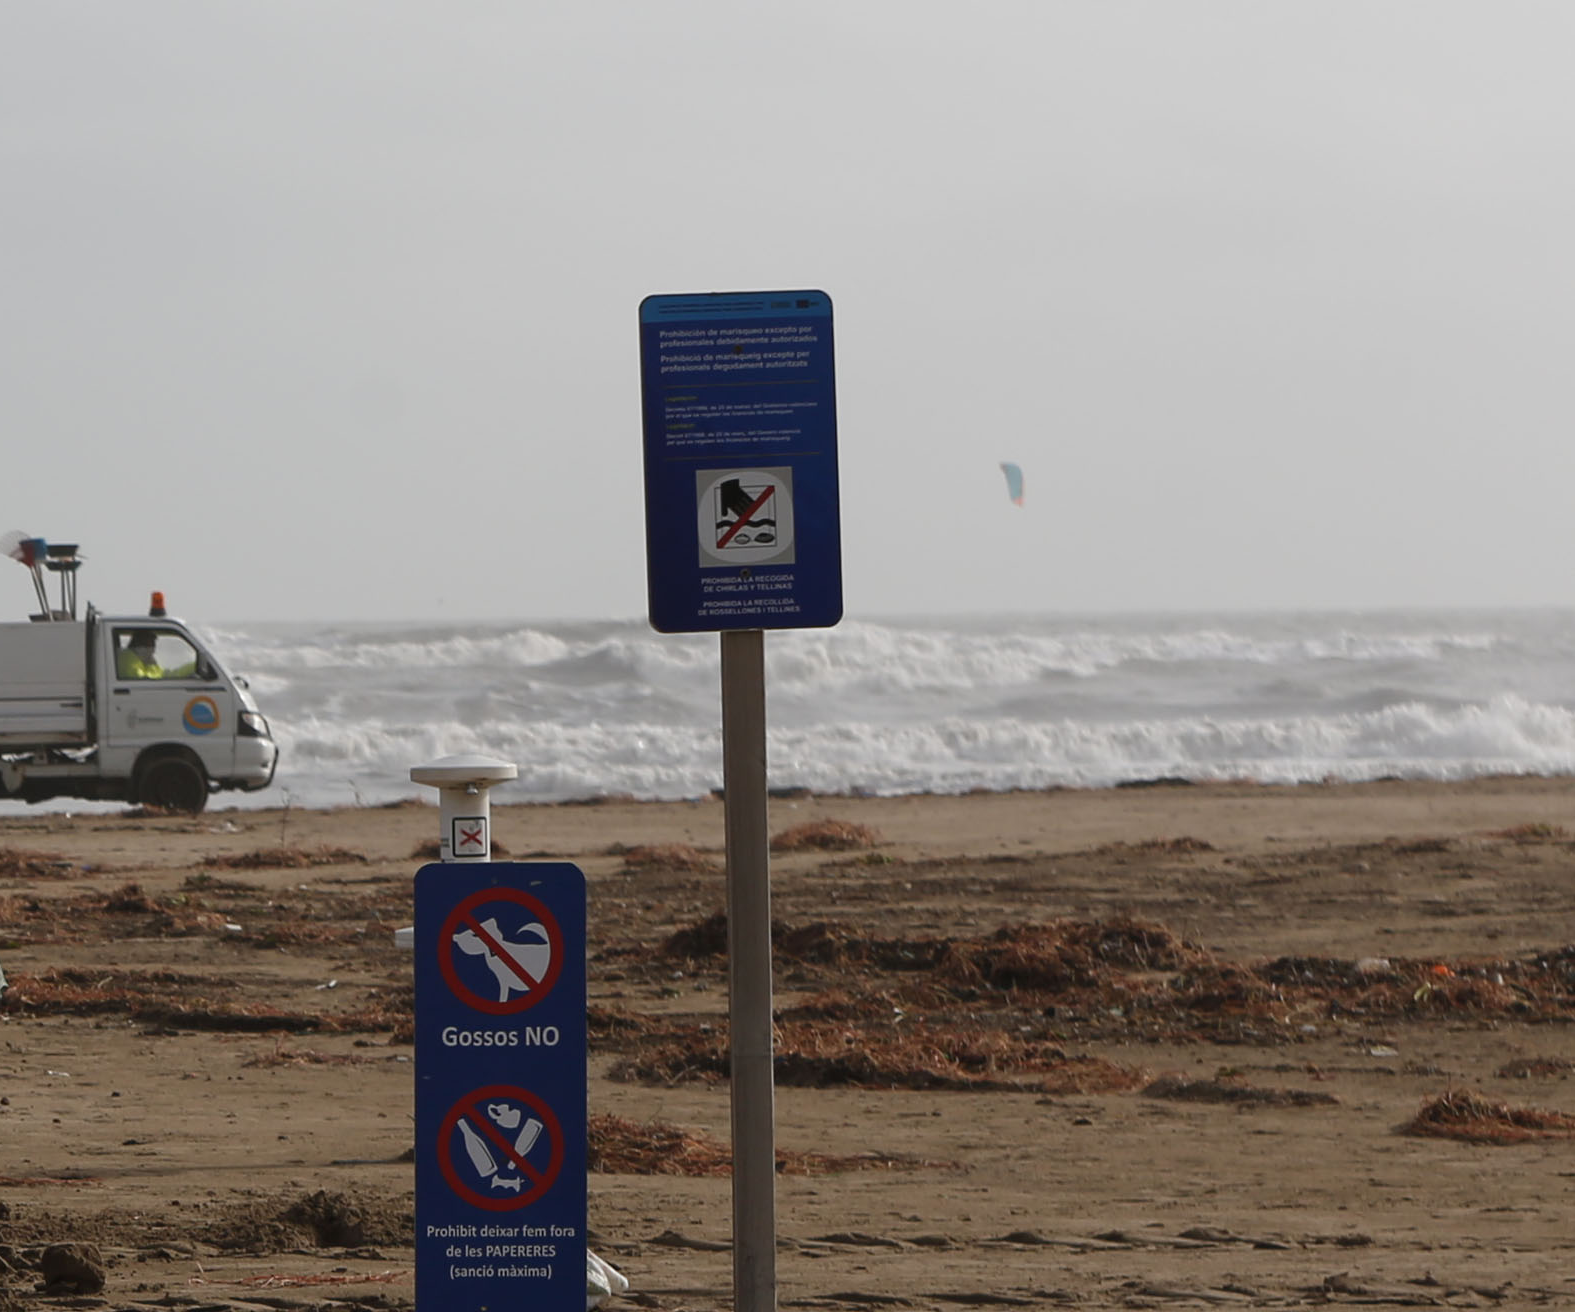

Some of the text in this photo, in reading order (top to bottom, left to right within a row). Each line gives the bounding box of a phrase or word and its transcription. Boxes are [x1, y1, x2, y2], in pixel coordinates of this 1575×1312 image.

[707, 328, 717, 336] de
[719, 327, 763, 336] marisqueo
[764, 326, 797, 335] excepto
[798, 326, 812, 335] por
[659, 334, 818, 348] profesionales debidamente autorizados
[703, 353, 714, 361] de
[796, 350, 811, 359] per
[701, 576, 742, 585] PROHIBIDA
[755, 574, 795, 582] RECOGIDA
[703, 585, 714, 593] DE
[757, 582, 793, 590] TELLINAS
[703, 599, 742, 608] PROHIBIDA
[754, 598, 795, 606] RECOLLIDA
[767, 605, 801, 613] TELLINES
[441, 1026, 560, 1047] Gossos NO
[426, 1225, 576, 1238] Prohibit deixar fem fora
[446, 1245, 556, 1257] de les PAPERERES
[450, 1264, 553, 1280] (sanció màxima)
